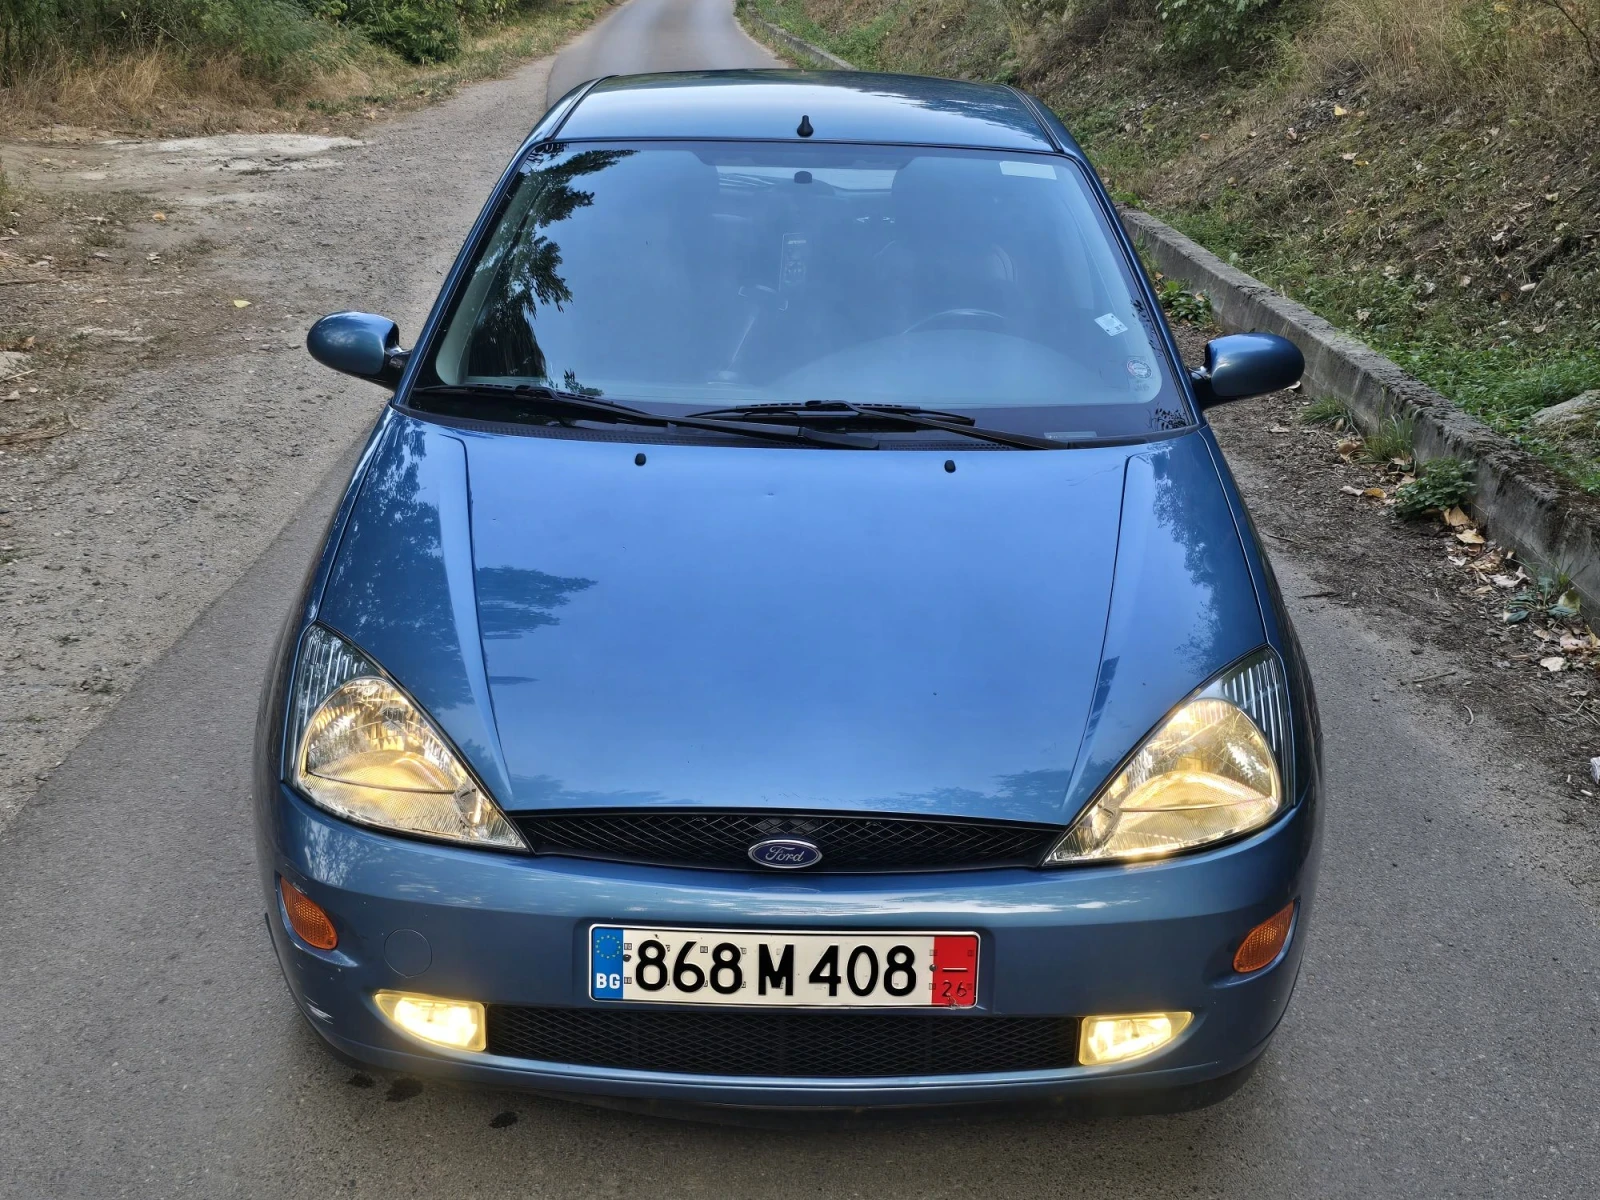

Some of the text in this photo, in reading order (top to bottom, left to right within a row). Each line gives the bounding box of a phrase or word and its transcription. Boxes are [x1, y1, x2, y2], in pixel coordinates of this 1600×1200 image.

[765, 845, 805, 862] Ford
[635, 939, 917, 997] 868 M 408
[596, 973, 620, 989] BG
[942, 980, 967, 997] 26
